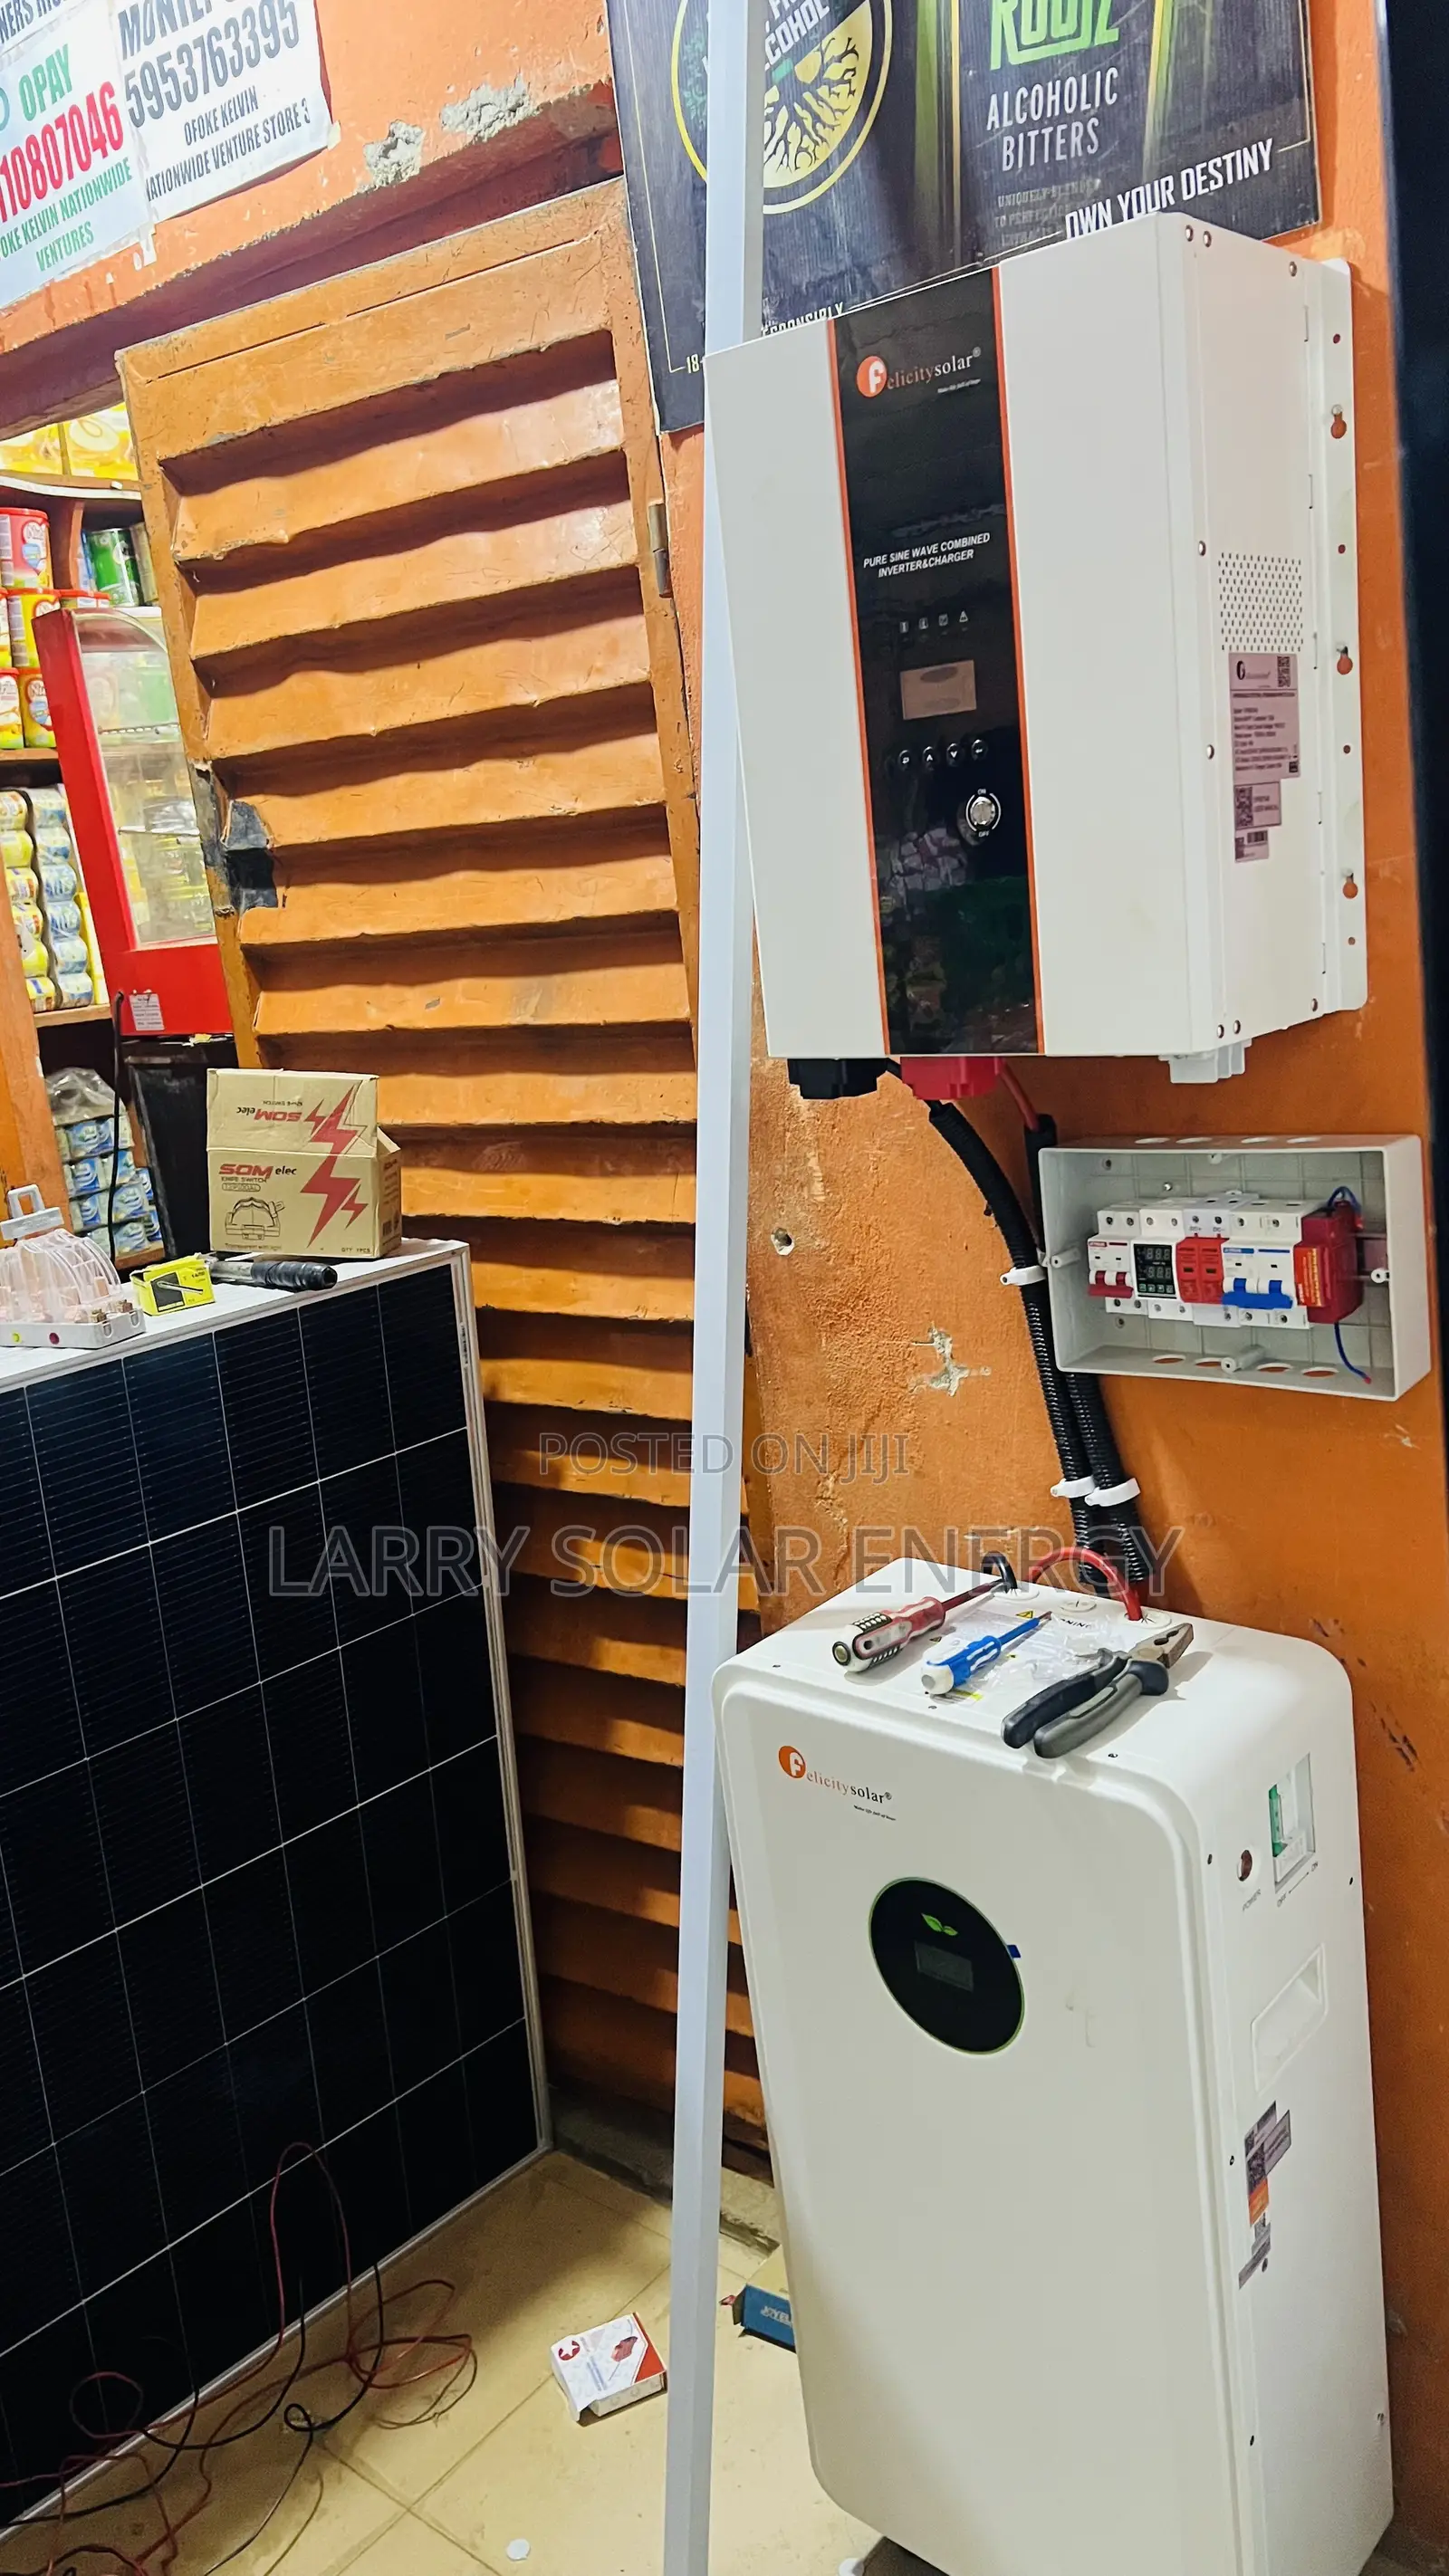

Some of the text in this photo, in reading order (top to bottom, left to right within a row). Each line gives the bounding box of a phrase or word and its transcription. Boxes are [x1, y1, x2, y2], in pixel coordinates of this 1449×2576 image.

[18, 43, 72, 121] OPAY
[124, 0, 299, 128] 5953763395
[184, 85, 259, 146] OFOKE KELVIN
[986, 67, 1119, 131] ALCOHOLIC
[211, 123, 261, 170] VENTURE
[262, 102, 302, 144] STORE
[302, 97, 311, 124] 3
[1002, 118, 1099, 172] BITTERS
[21, 203, 60, 245] KELVIN
[59, 157, 132, 221] NATIONWIDE
[1065, 198, 1113, 239] OWN
[1117, 175, 1176, 221] YOUR
[1180, 138, 1273, 201] DESTINY
[36, 221, 94, 272] VENTURES
[863, 532, 991, 569] PURE SINE WAVE COMBINED
[878, 549, 974, 578] INVERTER&CHARGER
[236, 1106, 302, 1122] SOM elec
[218, 1164, 297, 1180] SOM elec
